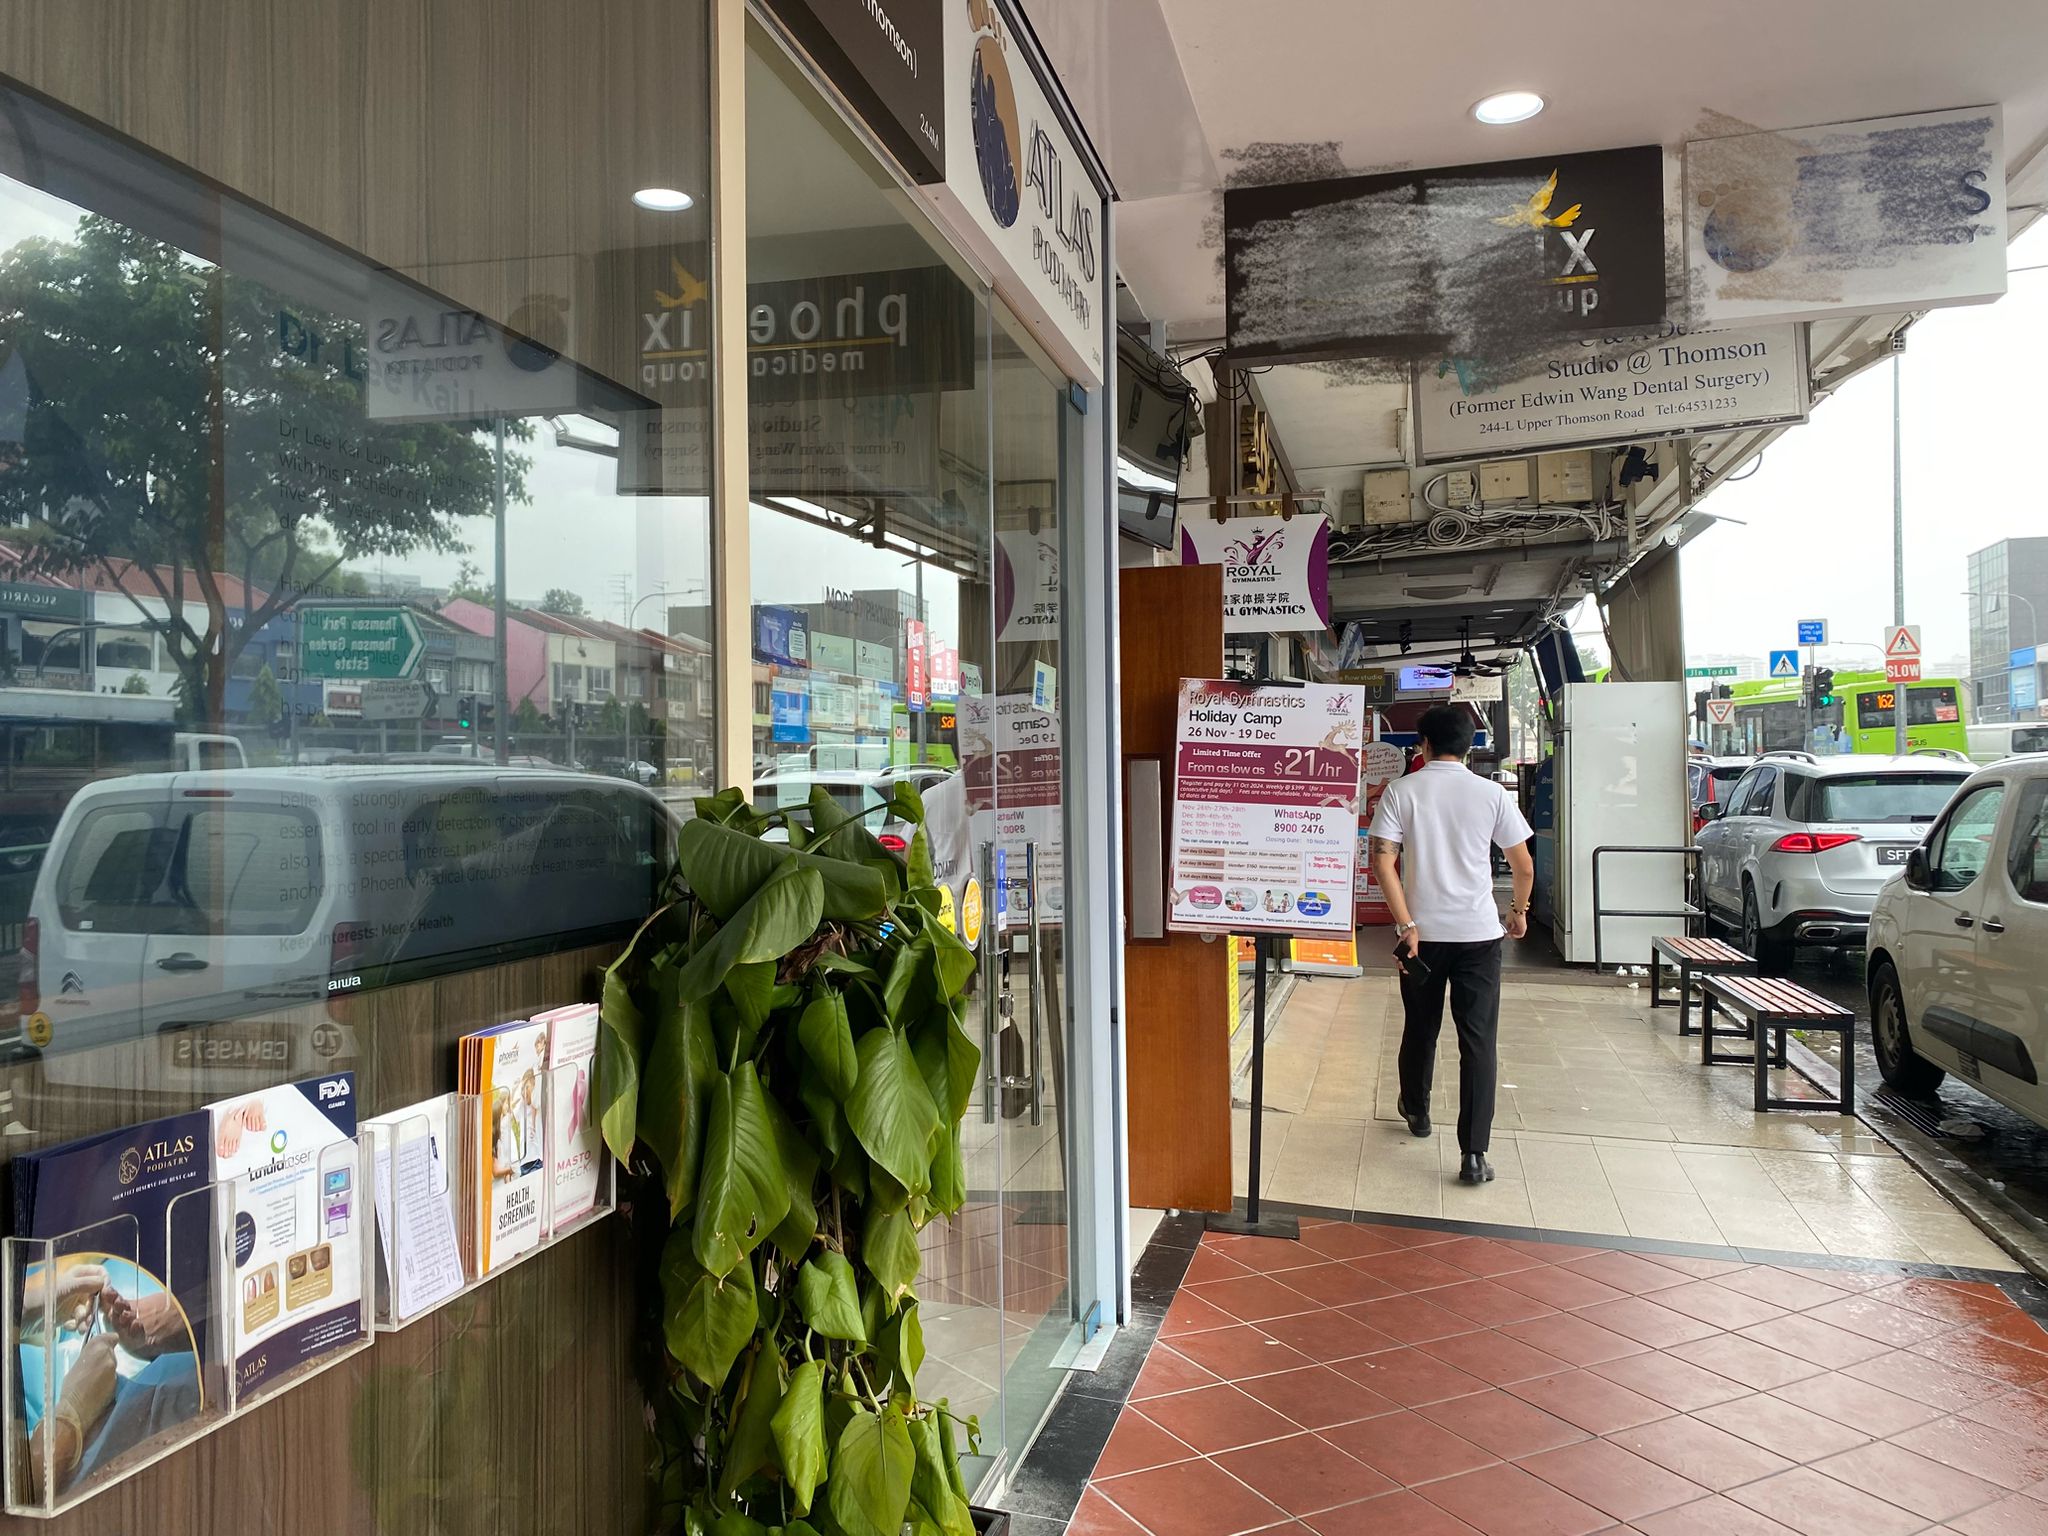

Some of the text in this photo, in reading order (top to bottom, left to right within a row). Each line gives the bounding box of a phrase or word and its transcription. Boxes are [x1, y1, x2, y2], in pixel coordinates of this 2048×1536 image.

[861, 0, 919, 79] homson)
[919, 113, 940, 152] 244M
[1025, 118, 1095, 283] ATLAS
[1032, 225, 1091, 331] PODIATRY
[1548, 339, 1768, 380] Studio @ Thomson
[1448, 367, 1771, 419] (Former Edwin Wang Dental Surgery)
[1479, 396, 1738, 434] 244-L Upper Thomson Road Tel:64531233
[1226, 565, 1282, 577] ROYAL
[1232, 576, 1276, 584] GYMNASTICS
[1239, 604, 1306, 617] GYMNASTICS
[1886, 664, 1920, 678] SLOW
[1189, 690, 1306, 709] Royal Gymnastics
[1876, 693, 1895, 710] 162
[1188, 709, 1283, 727] Holiday Camp
[1187, 726, 1276, 740] 26 Nov 19 Dec
[1192, 748, 1262, 759] Limited Time Offer
[1187, 761, 1266, 776] From as low as
[1274, 808, 1322, 822] WhatsApp
[1274, 823, 1325, 835] 8900 2476
[327, 975, 361, 991] aiwa
[499, 1049, 520, 1063] phoenix
[318, 1078, 350, 1101] FDA
[144, 1135, 194, 1163] ATLAS
[147, 1155, 190, 1174] PODIATRY
[556, 1149, 592, 1173] MASTO
[506, 1185, 530, 1210] HEALTH
[498, 1199, 536, 1231] SCREENING
[243, 1354, 267, 1379] ATLAS
